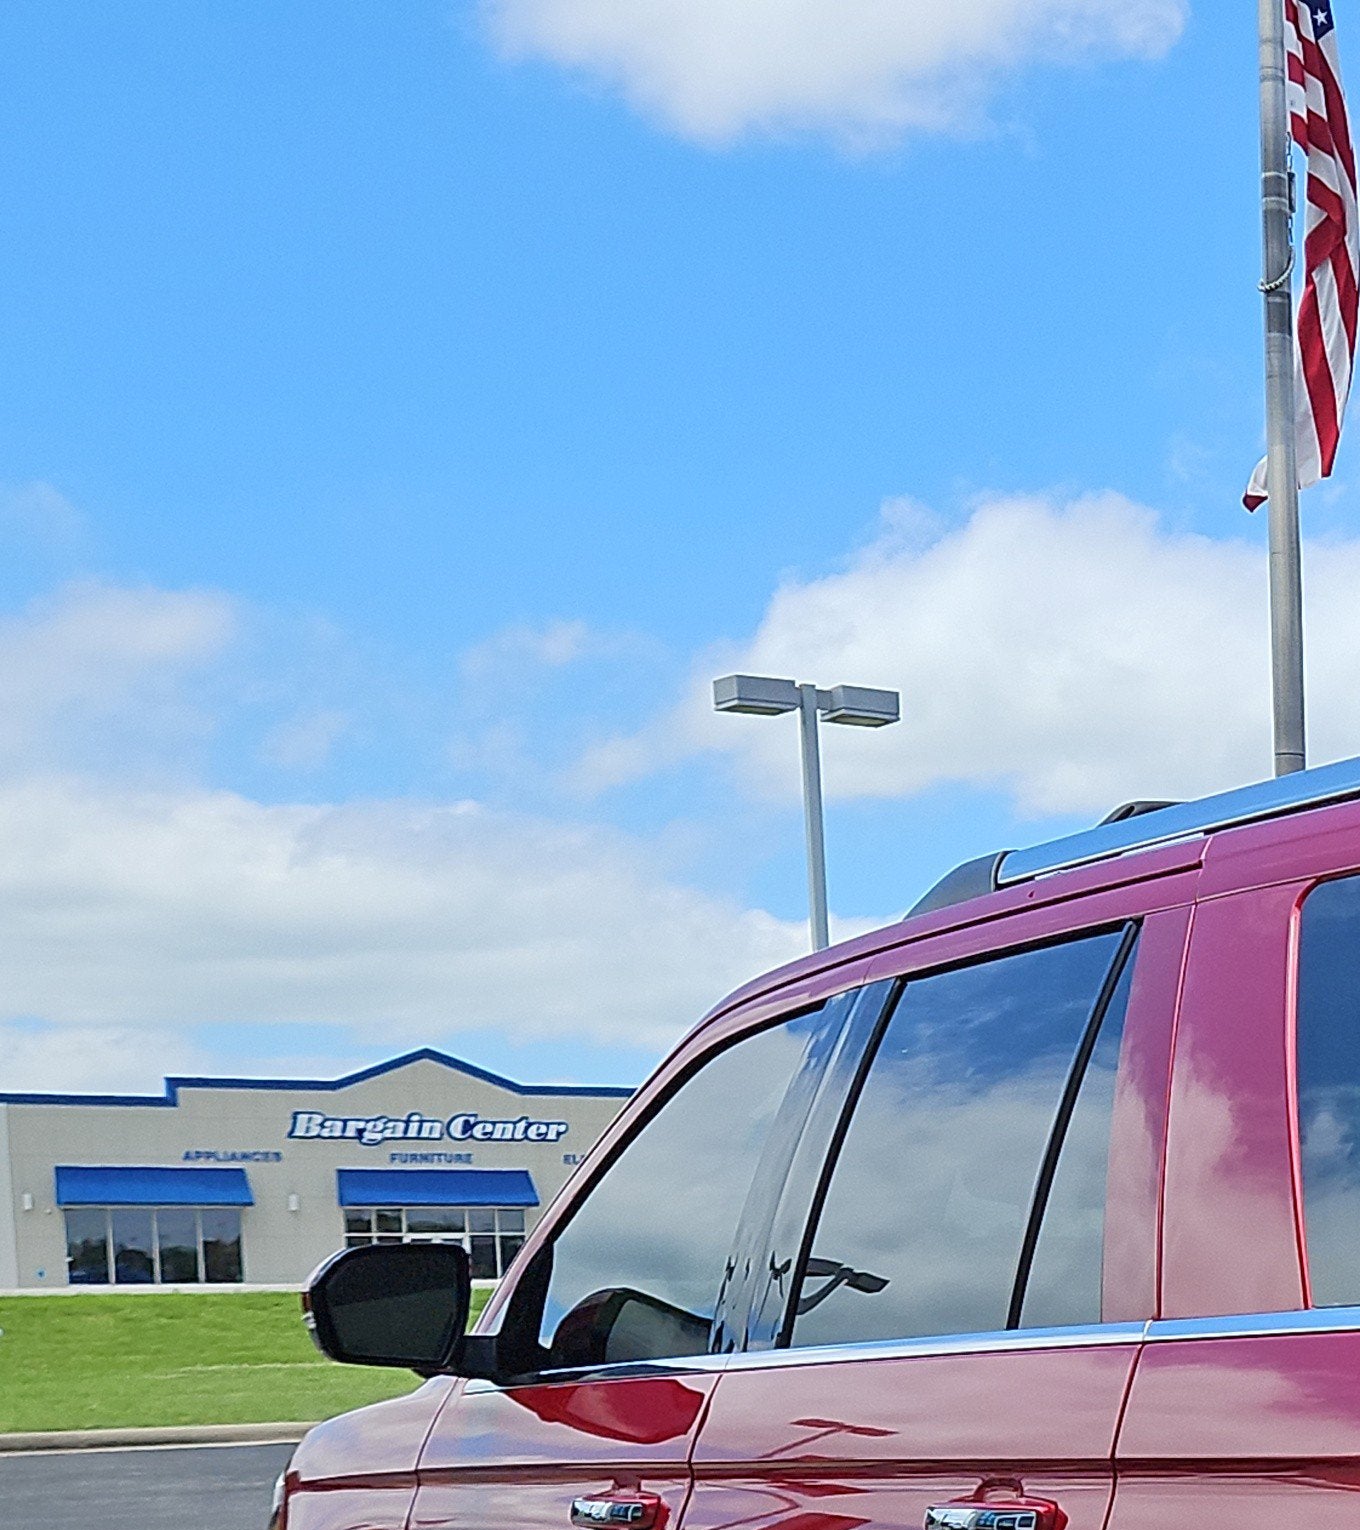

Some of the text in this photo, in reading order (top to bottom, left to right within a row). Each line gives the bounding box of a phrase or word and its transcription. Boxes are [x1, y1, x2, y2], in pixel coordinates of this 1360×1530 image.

[288, 1111, 568, 1146] Bargain Center
[182, 1151, 282, 1162] APPLIANCES
[389, 1153, 474, 1164] FURNITURE
